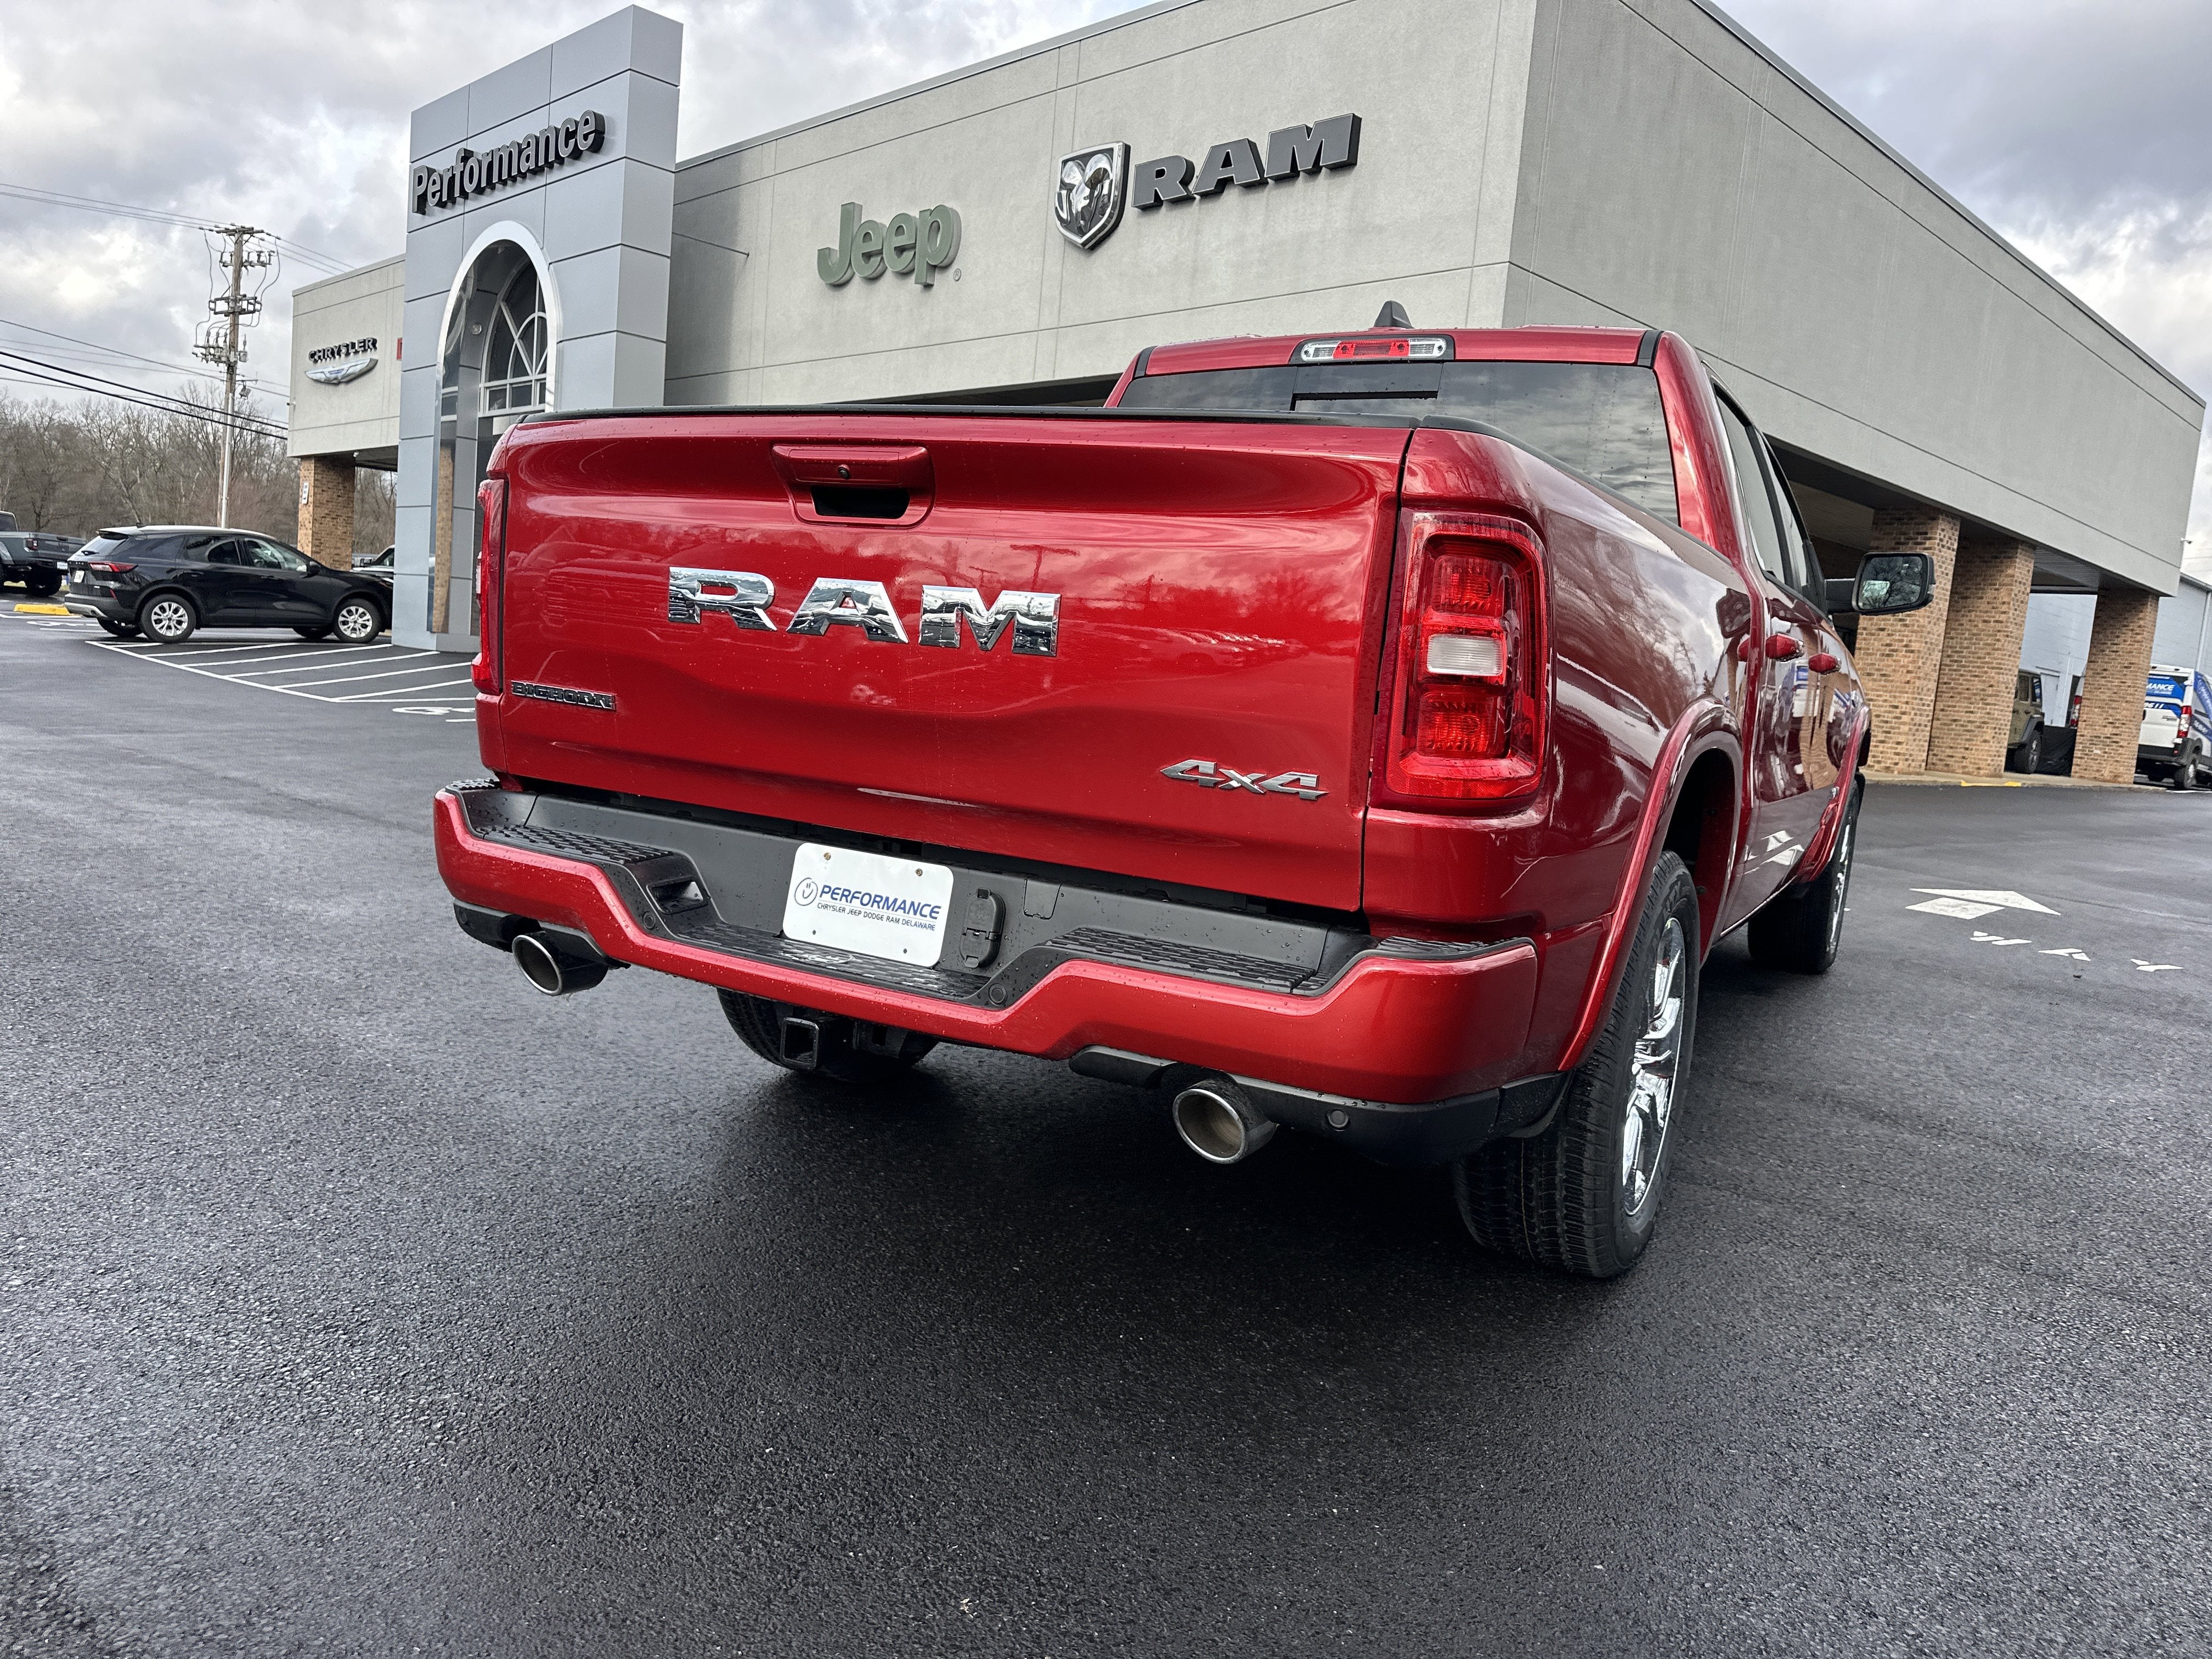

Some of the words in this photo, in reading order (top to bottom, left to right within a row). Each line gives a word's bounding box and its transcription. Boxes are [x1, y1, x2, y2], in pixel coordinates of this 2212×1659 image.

[412, 110, 605, 215] Performance
[1132, 113, 1362, 210] RAM
[817, 202, 962, 286] Jeep
[308, 337, 377, 363] CHRYSLER
[668, 567, 1062, 657] RAM
[817, 902, 846, 914] CHRYSLER
[847, 908, 862, 917] JEEP
[863, 911, 884, 921] DODGE
[885, 915, 900, 924] RAM
[901, 918, 936, 931] DELAWARE
[819, 884, 942, 919] PERFORMANCE
